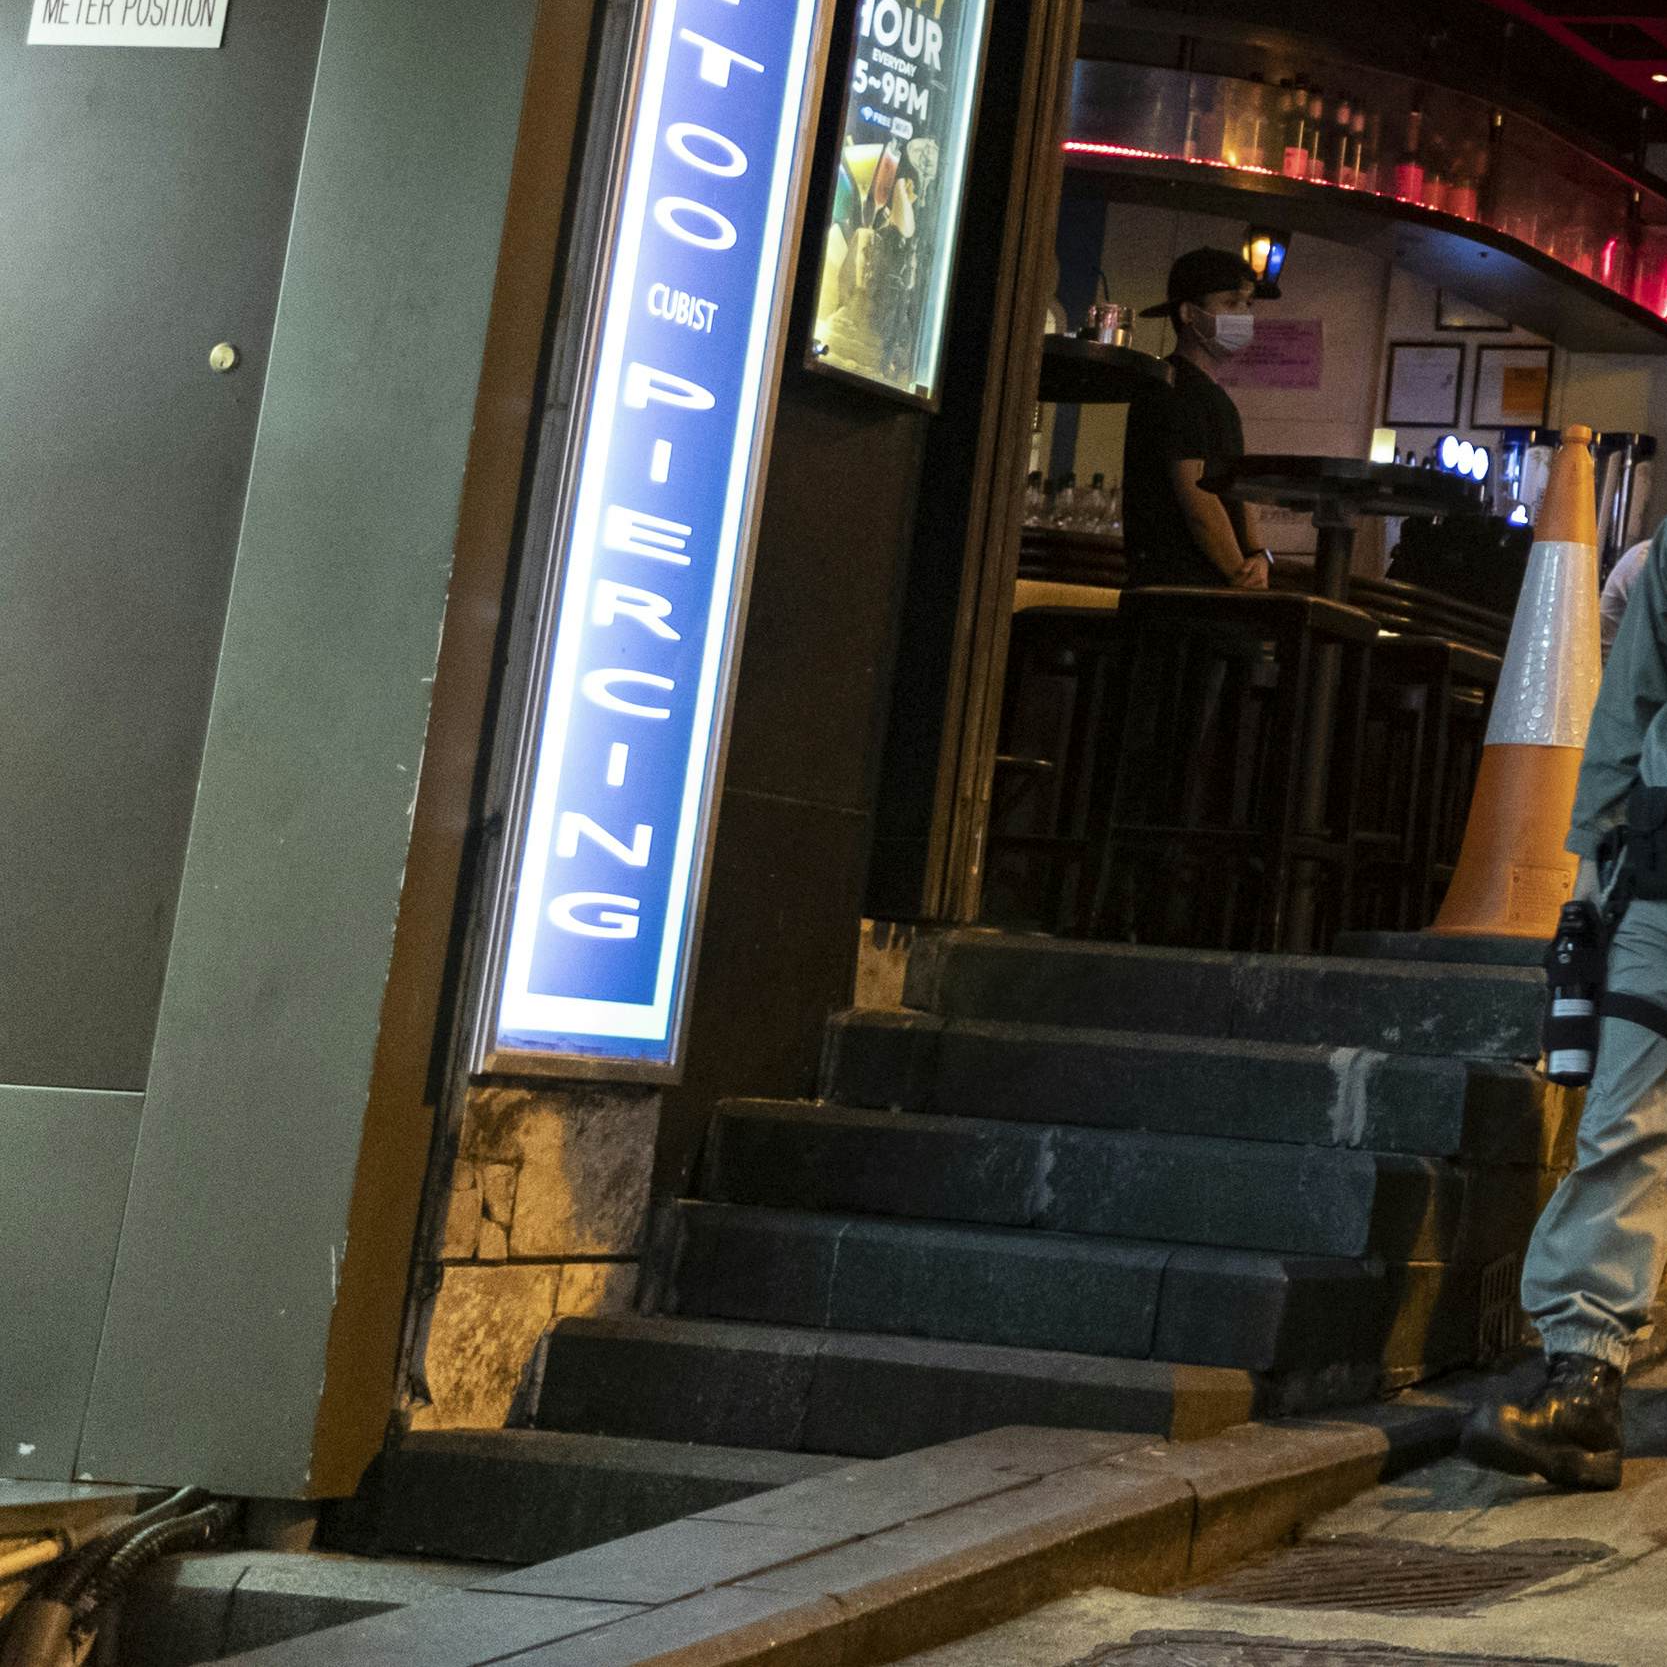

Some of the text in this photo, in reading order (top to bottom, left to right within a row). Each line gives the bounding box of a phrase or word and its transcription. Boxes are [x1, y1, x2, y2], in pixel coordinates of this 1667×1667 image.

[872, 48, 917, 78] EVERYDAY
[648, 282, 719, 333] CUBIST
[548, 362, 716, 940] PIERCING
